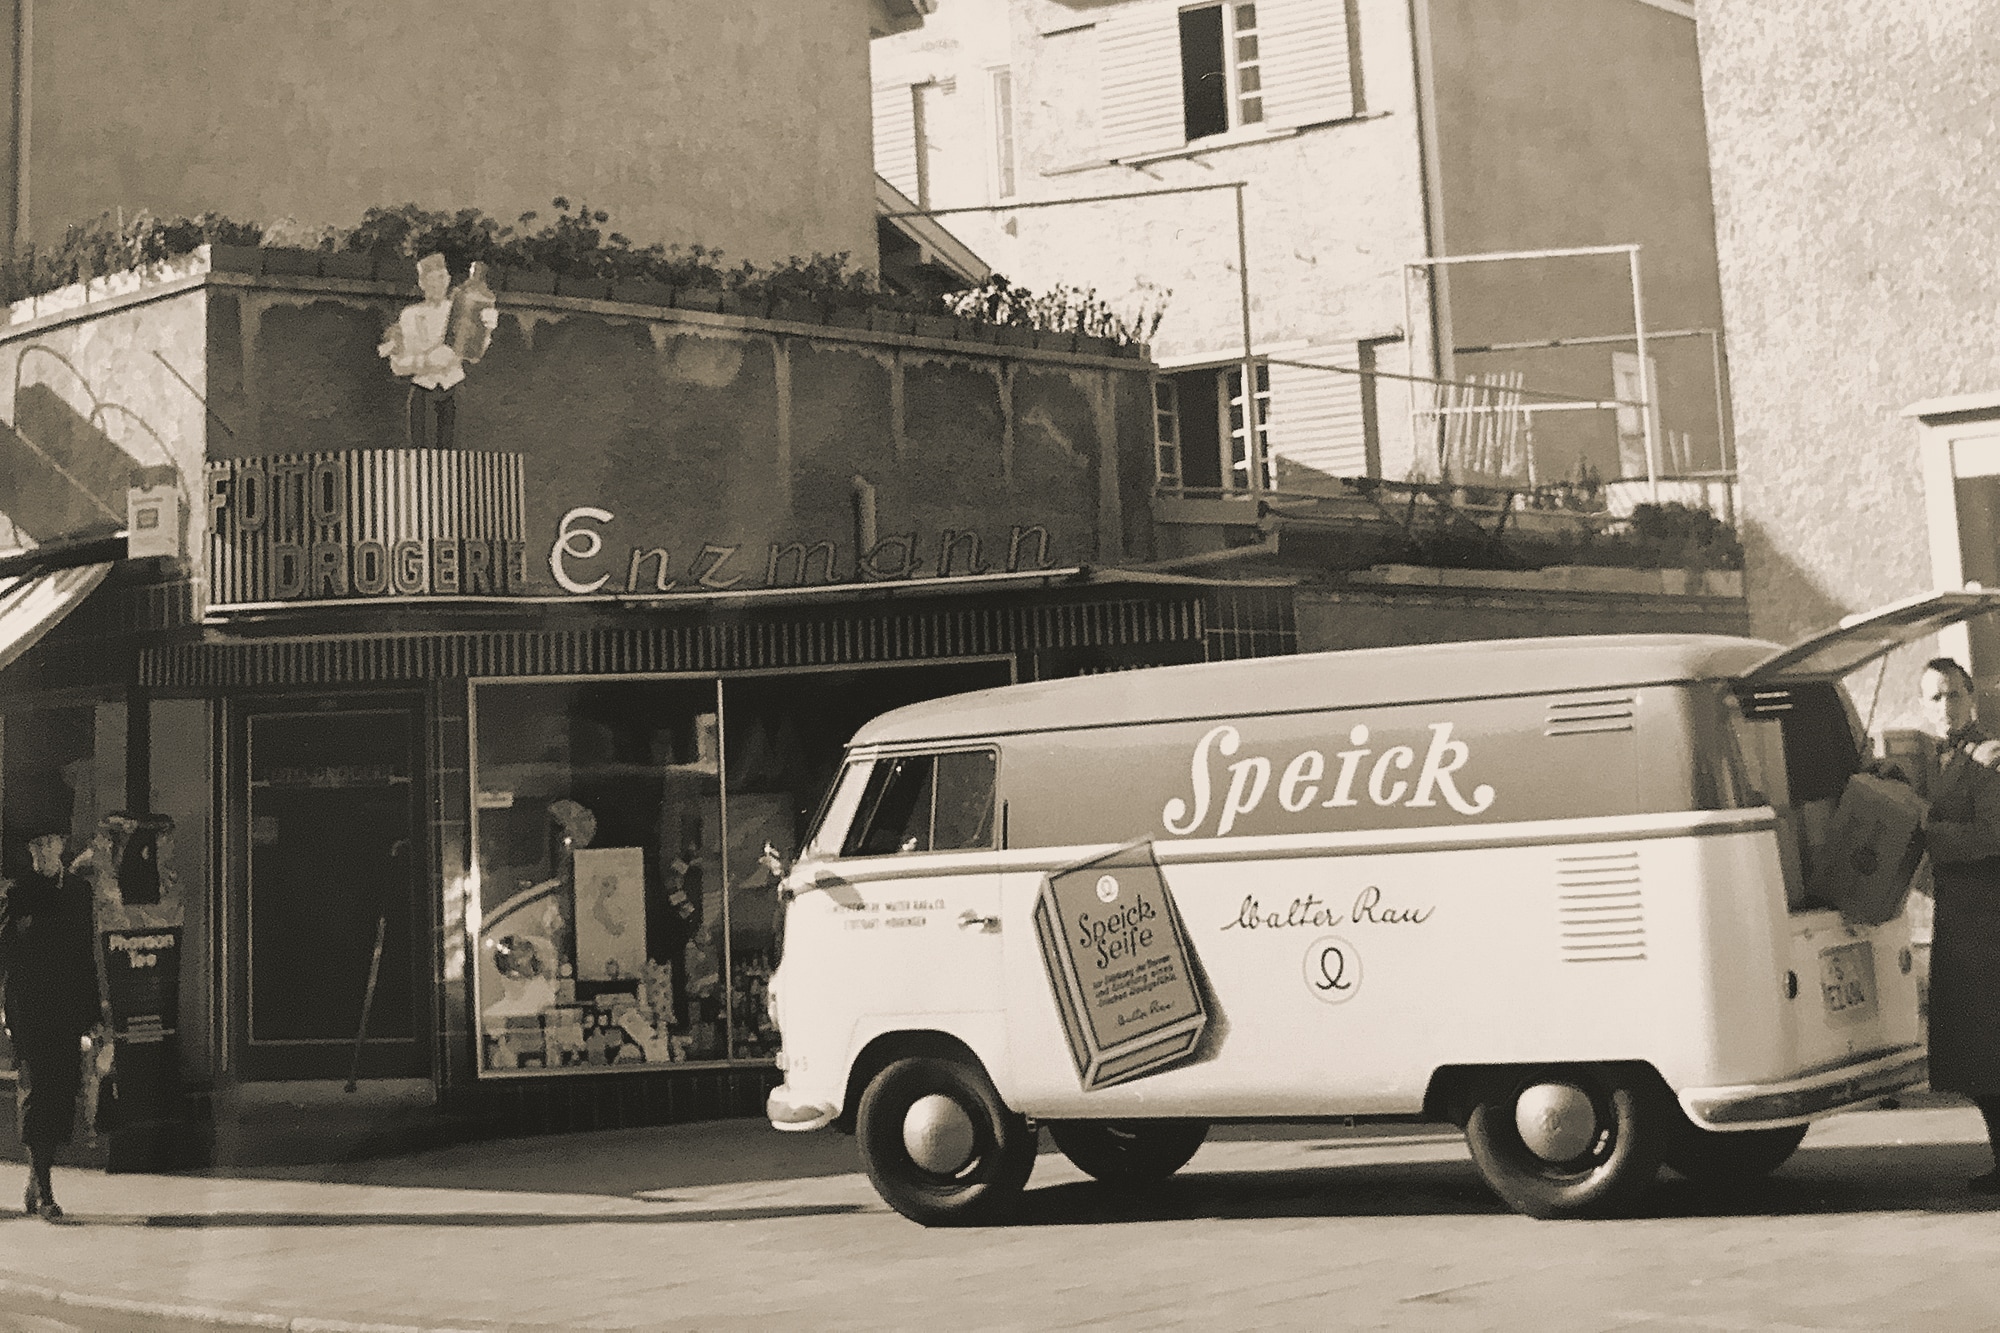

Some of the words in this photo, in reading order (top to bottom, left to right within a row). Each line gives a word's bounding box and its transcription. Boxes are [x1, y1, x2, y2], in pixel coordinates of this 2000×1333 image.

[207, 460, 343, 534] FOTO
[272, 538, 525, 598] DROGERIE
[549, 506, 1057, 593] Enzmann
[1162, 722, 1495, 836] Speick
[1078, 894, 1156, 949] Speick
[1220, 894, 1344, 931] Walter
[1352, 886, 1436, 924] Rau
[1097, 926, 1154, 969] Seife
